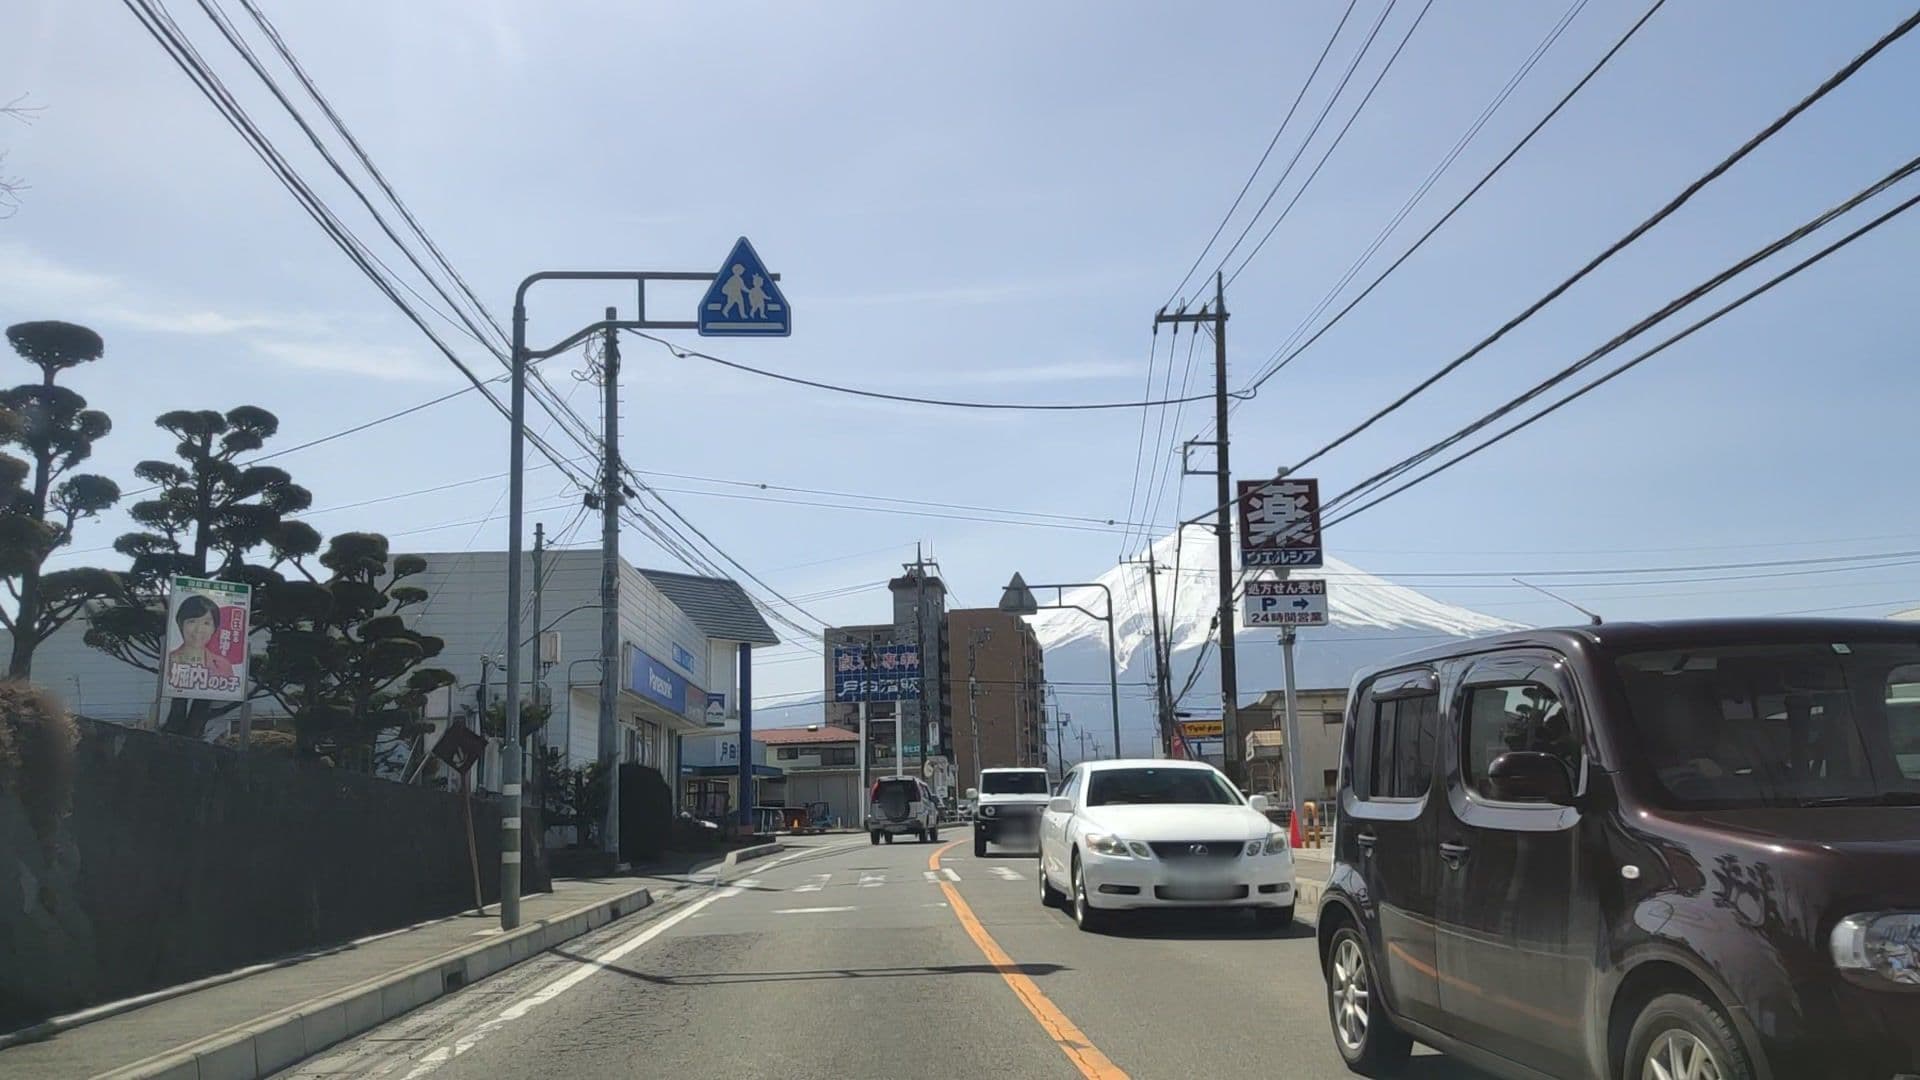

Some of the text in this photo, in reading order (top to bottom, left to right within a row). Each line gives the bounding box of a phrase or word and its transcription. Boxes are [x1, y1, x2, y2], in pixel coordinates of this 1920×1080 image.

[1246, 482, 1315, 547] 薬
[1247, 551, 1317, 565] ウエルシア
[1248, 582, 1323, 594] 処方せん受付
[1261, 598, 1277, 611] P
[1251, 612, 1322, 623] 24時間営業
